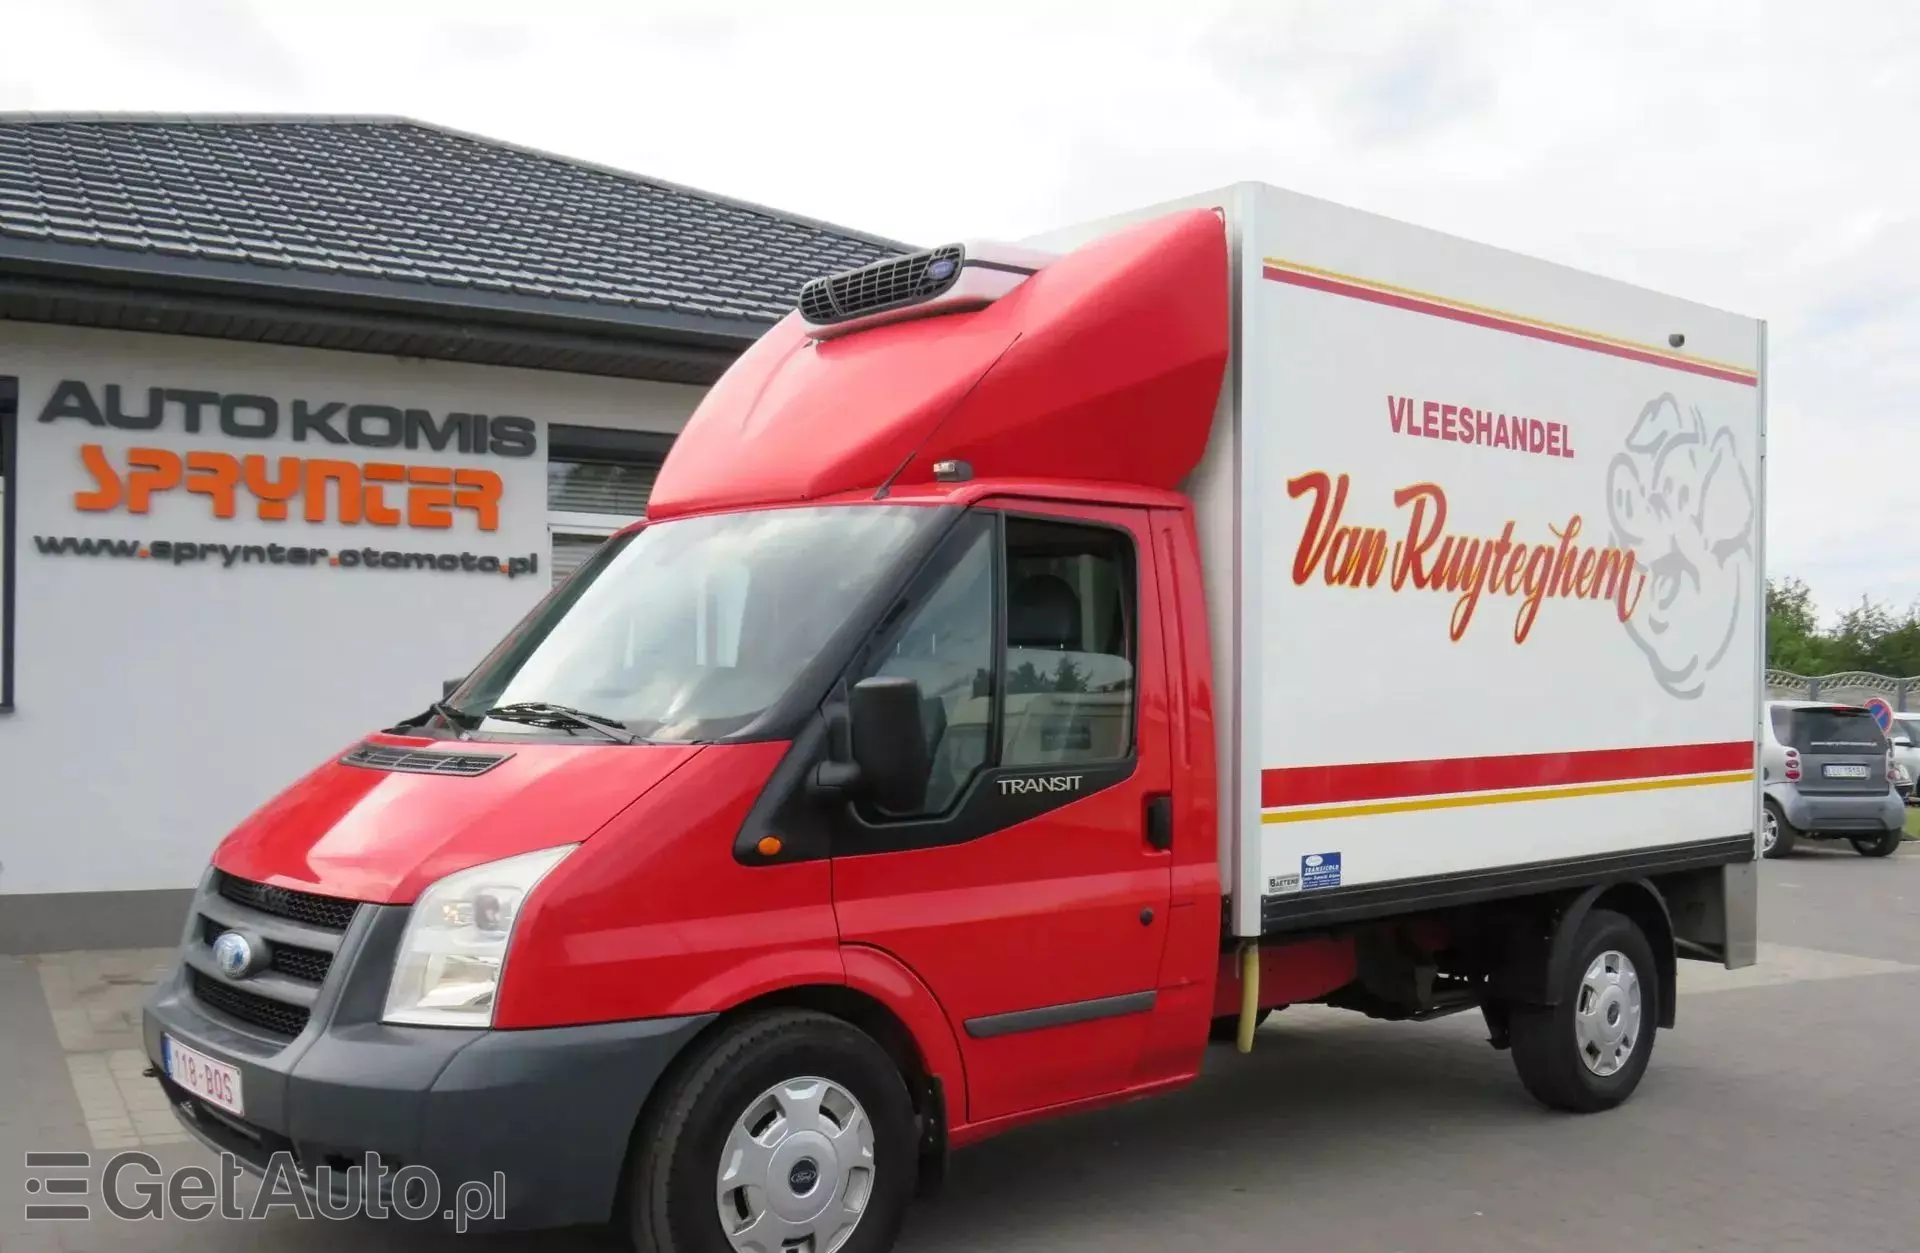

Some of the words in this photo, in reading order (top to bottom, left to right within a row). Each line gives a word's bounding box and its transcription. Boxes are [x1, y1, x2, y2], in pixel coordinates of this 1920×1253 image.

[38, 379, 279, 438] AUTO
[291, 398, 537, 457] KOMIS
[1387, 395, 1575, 459] VLEESHANDEL
[73, 443, 504, 531] SPRYNTER
[33, 535, 538, 579] www.sprynter.otomoto.pl
[1287, 471, 1388, 589] Van
[1391, 482, 1646, 644] Ruyteghem
[997, 775, 1083, 796] TRANSIT
